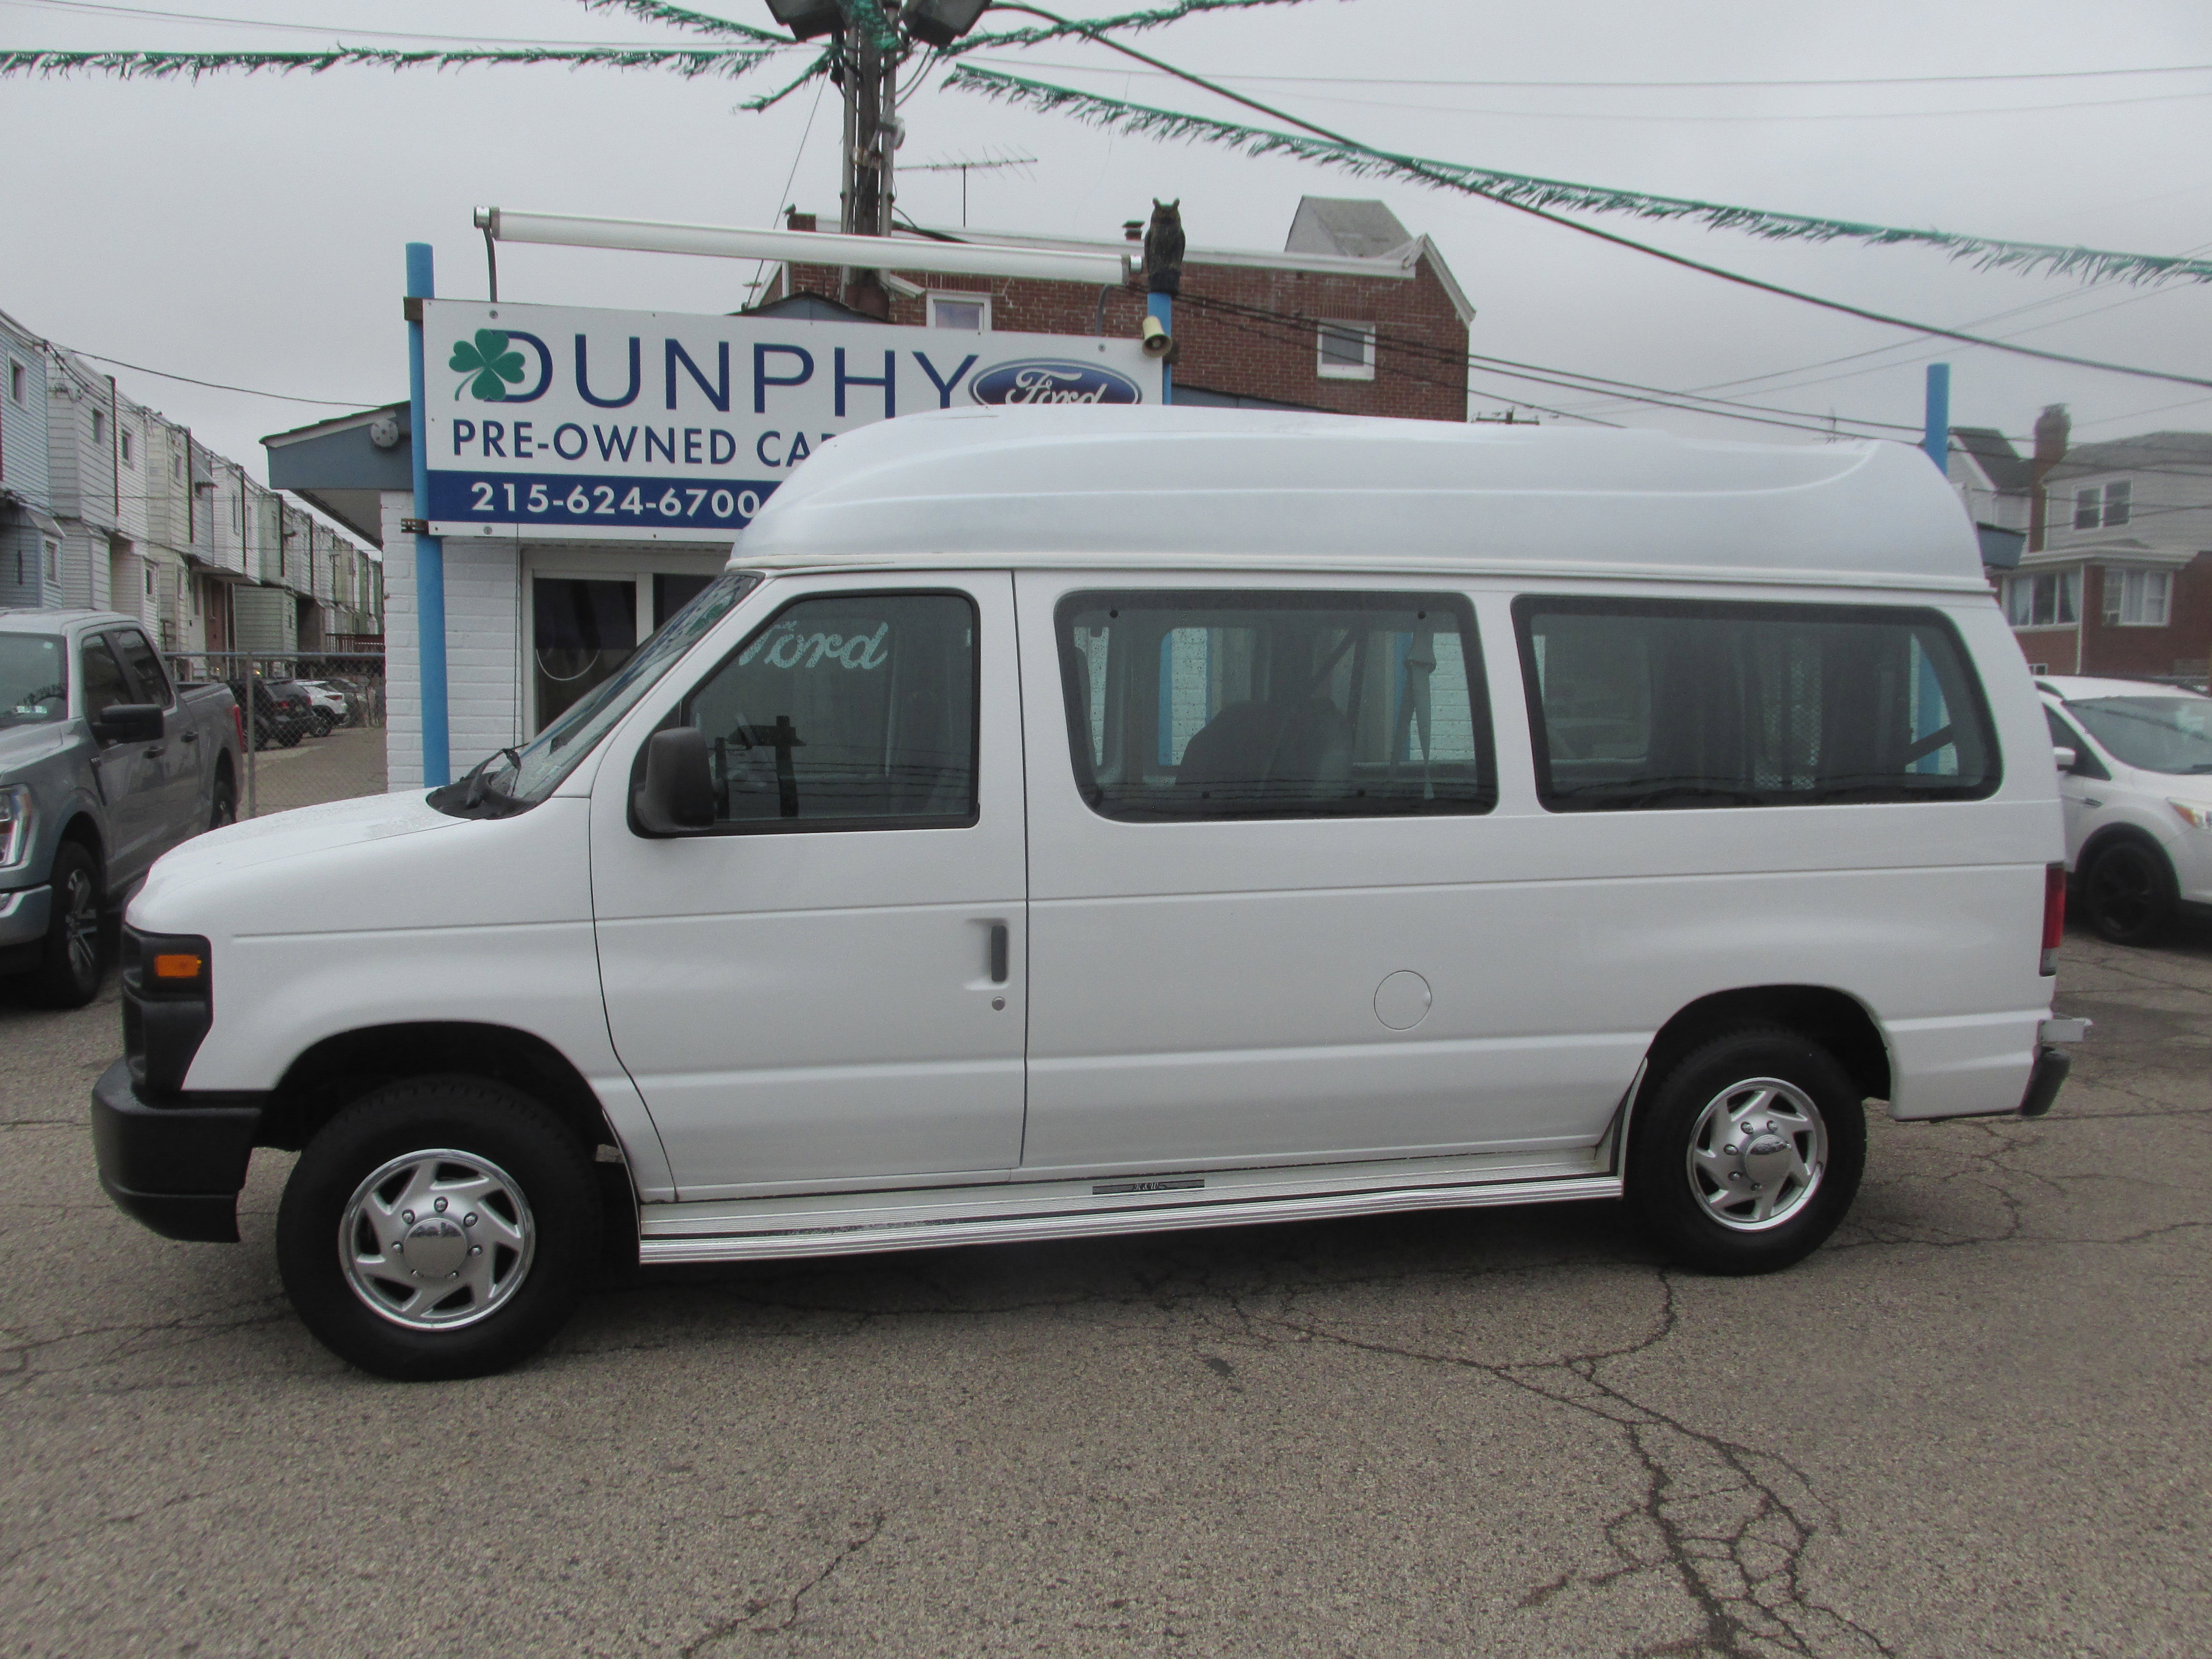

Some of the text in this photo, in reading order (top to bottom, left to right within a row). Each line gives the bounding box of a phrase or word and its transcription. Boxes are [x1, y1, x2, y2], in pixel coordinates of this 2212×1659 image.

[483, 328, 979, 419] DUNPHY
[1005, 368, 1108, 404] Ford
[453, 419, 837, 468] PRE-OWNED CA
[471, 482, 760, 518] 215-624-6700
